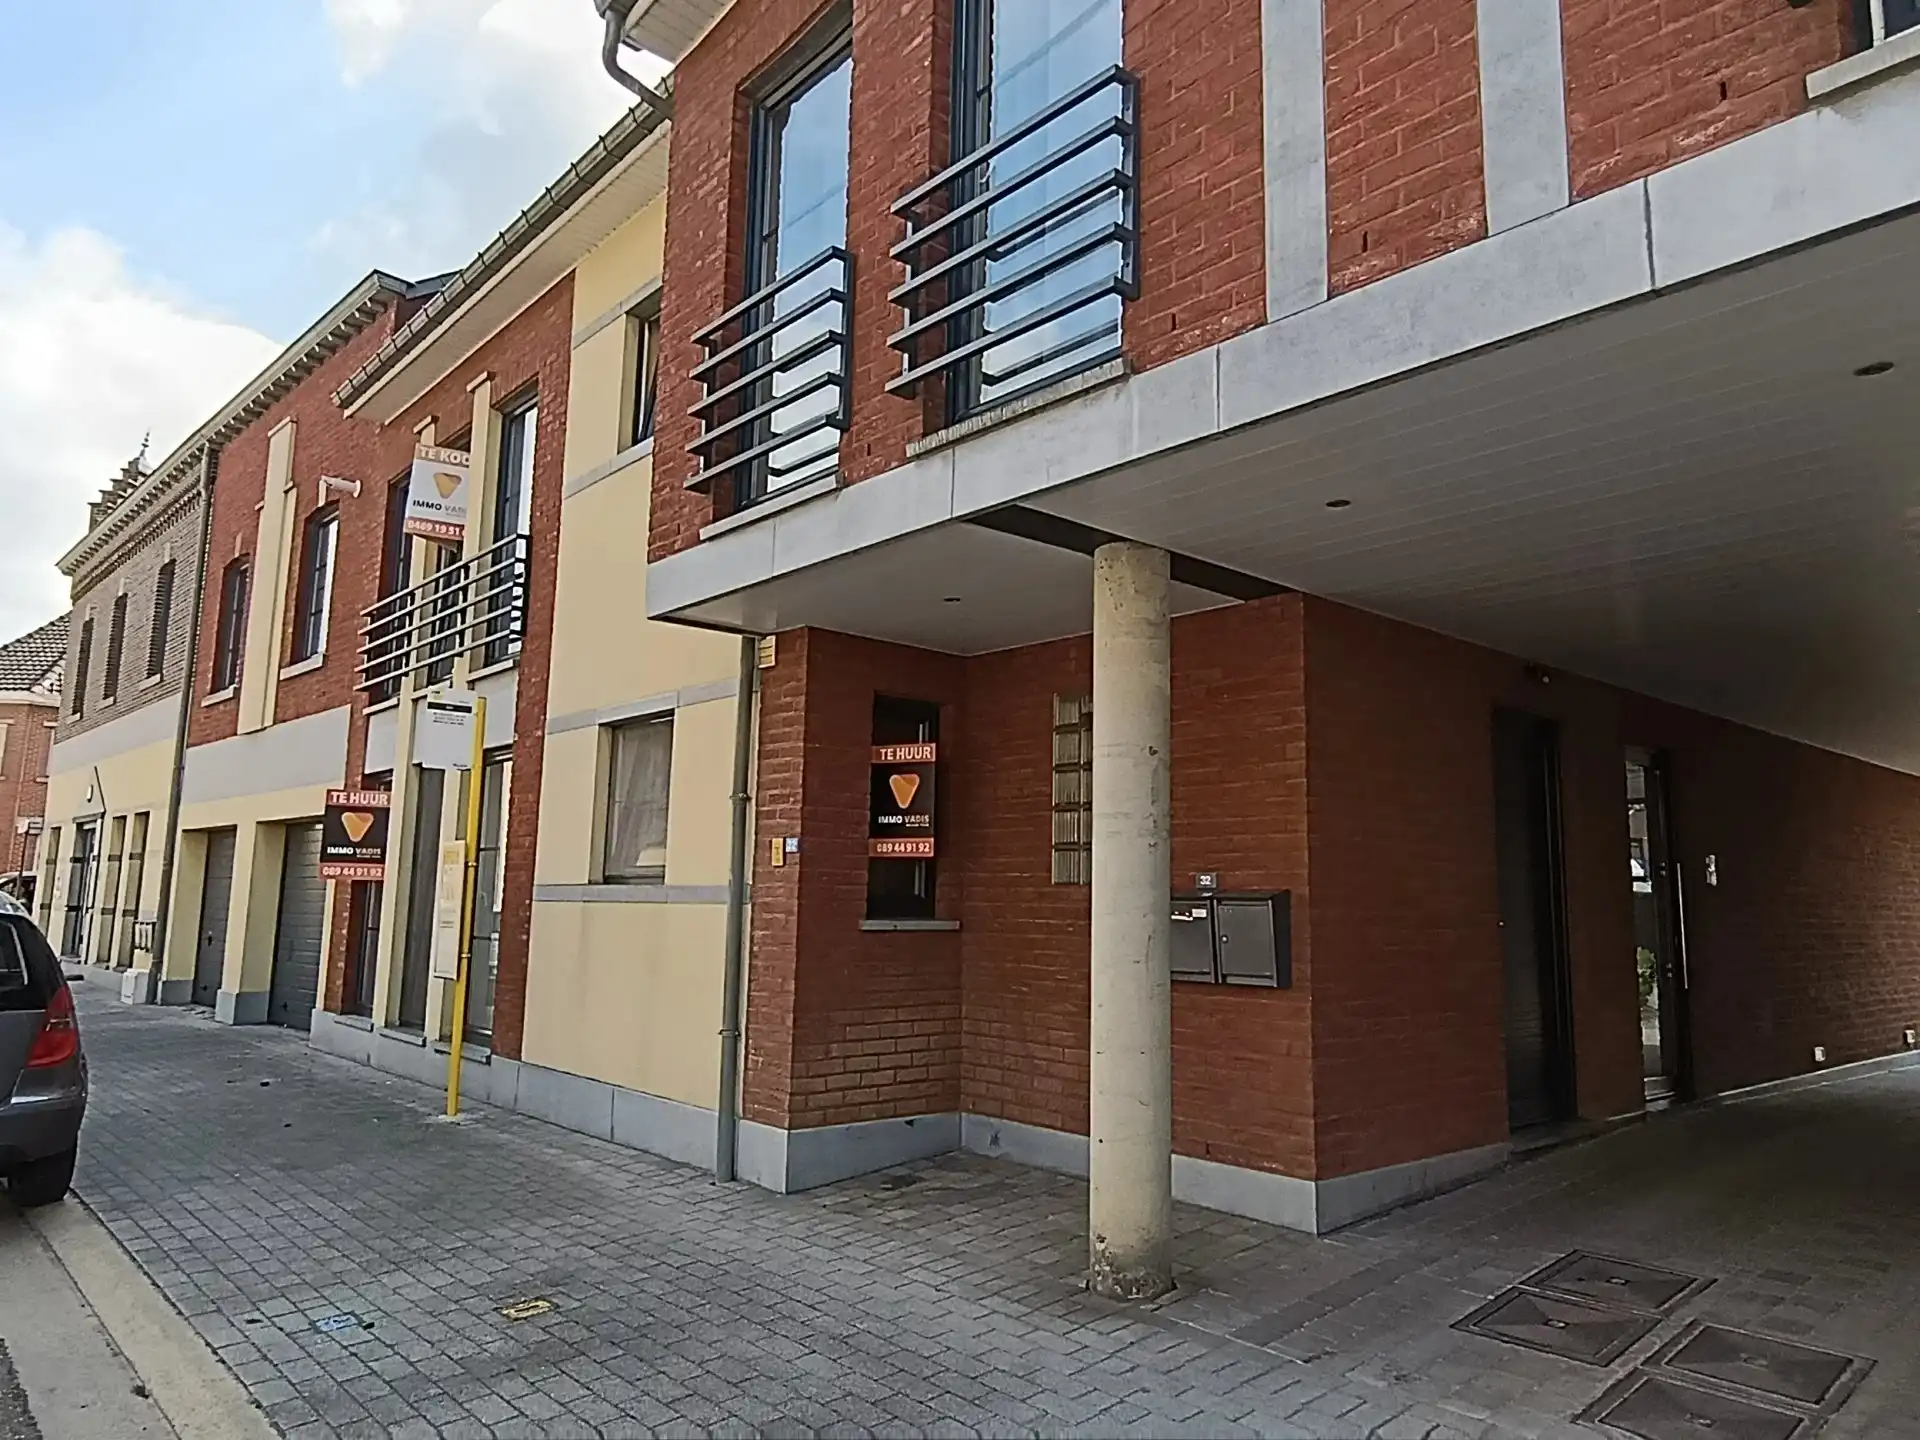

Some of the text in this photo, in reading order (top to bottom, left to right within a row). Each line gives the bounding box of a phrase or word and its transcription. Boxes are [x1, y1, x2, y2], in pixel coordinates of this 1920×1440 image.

[419, 446, 470, 466] TE KOO
[413, 500, 467, 513] IMMO VADI
[447, 525, 460, 536] 51
[879, 746, 931, 761] TE HUUR
[331, 791, 388, 805] TE HUUR
[878, 814, 930, 824] IMMO VADIS
[876, 842, 930, 852] 089 44 91 92
[343, 867, 355, 876] 44
[356, 867, 368, 876] 91
[370, 868, 382, 877] 92
[1200, 876, 1211, 885] 32
